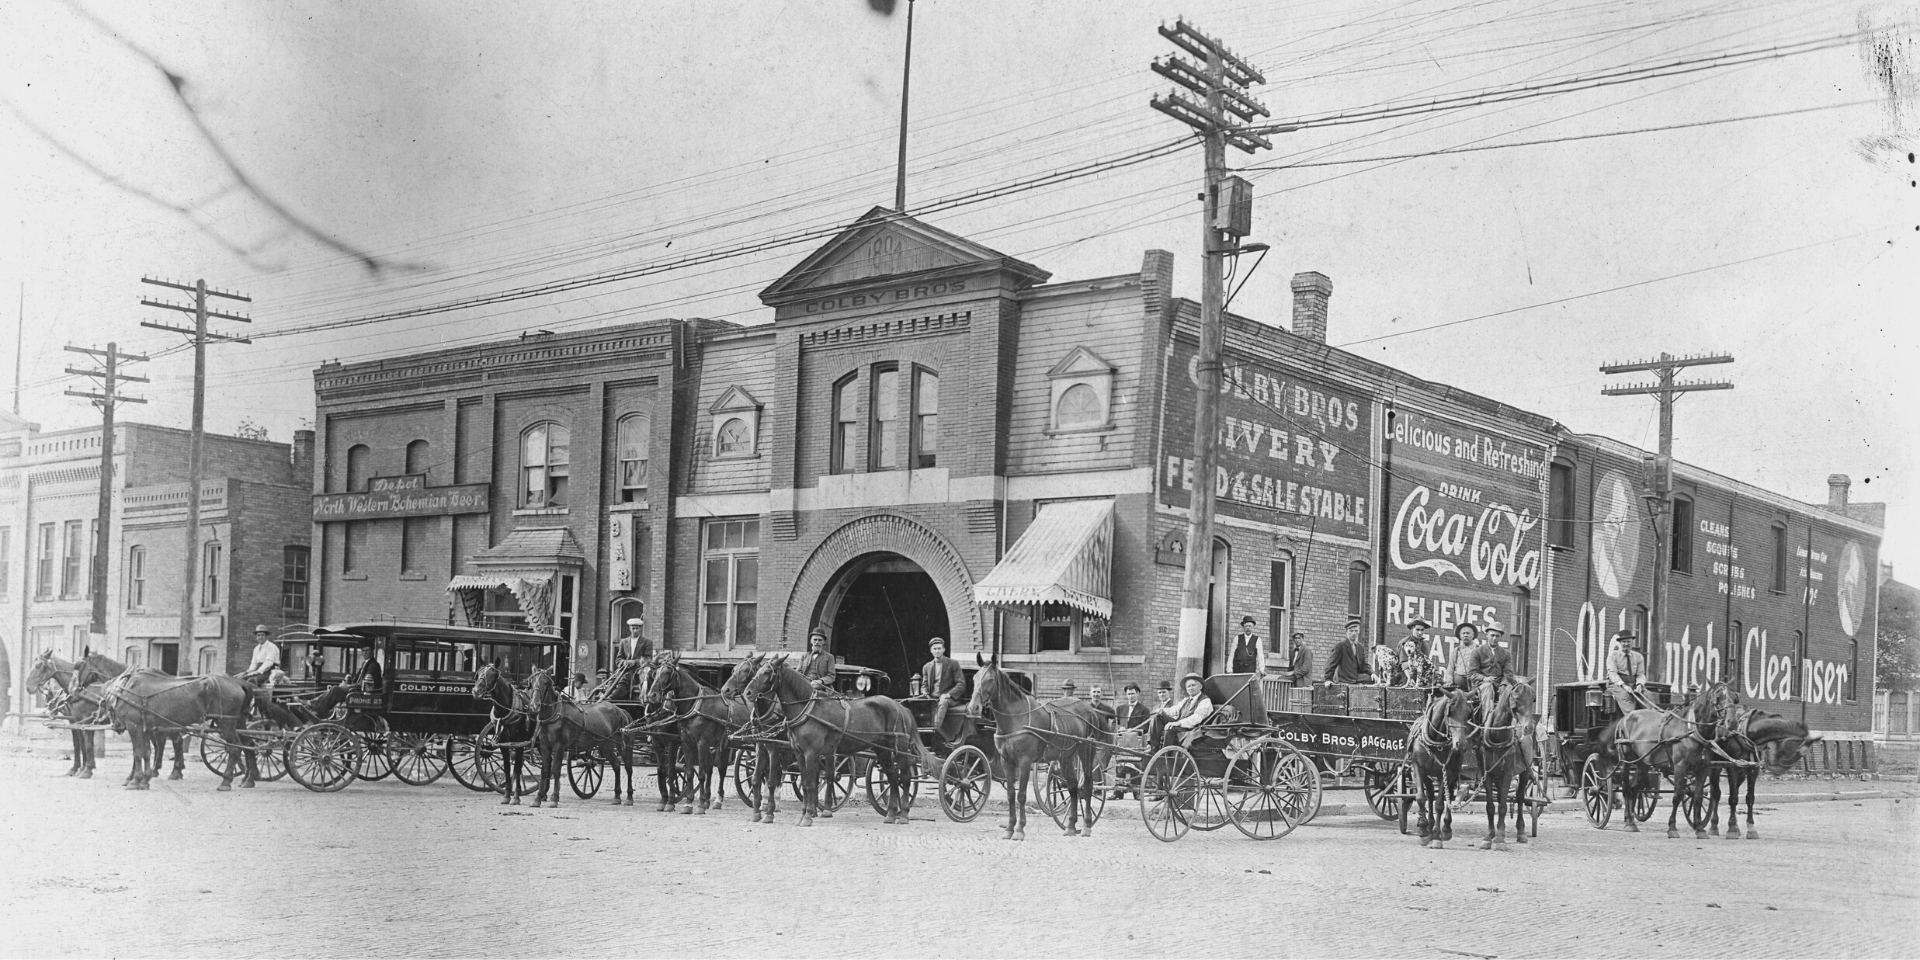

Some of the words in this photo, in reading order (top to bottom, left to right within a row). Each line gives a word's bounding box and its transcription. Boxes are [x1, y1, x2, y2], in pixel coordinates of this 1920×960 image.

[805, 291, 886, 314] COLBY
[1218, 416, 1340, 471] IVERY
[1455, 434, 1478, 462] and
[1484, 436, 1547, 492] Refreshing
[373, 478, 418, 492] Depot
[1166, 456, 1229, 497] FED
[1250, 474, 1299, 512] SALE
[1300, 485, 1365, 525] STABLE
[1438, 481, 1482, 503] DRINK
[313, 497, 346, 515] North
[348, 495, 389, 513] Western
[390, 493, 447, 512] Bohemian
[1390, 486, 1542, 589] Coca-Cola
[1700, 520, 1730, 537] CLEANS
[609, 519, 629, 586] BAR
[1387, 593, 1497, 633] RELIEVES
[1648, 612, 1720, 694] utch
[1744, 627, 1848, 705] Cleanser
[400, 682, 436, 692] COLBY
[439, 685, 470, 694] BROS.
[349, 696, 371, 704] PHONE
[1278, 729, 1317, 743] COLBY
[1322, 733, 1358, 747] BROS.
[1361, 735, 1405, 750] BAGGAGE
